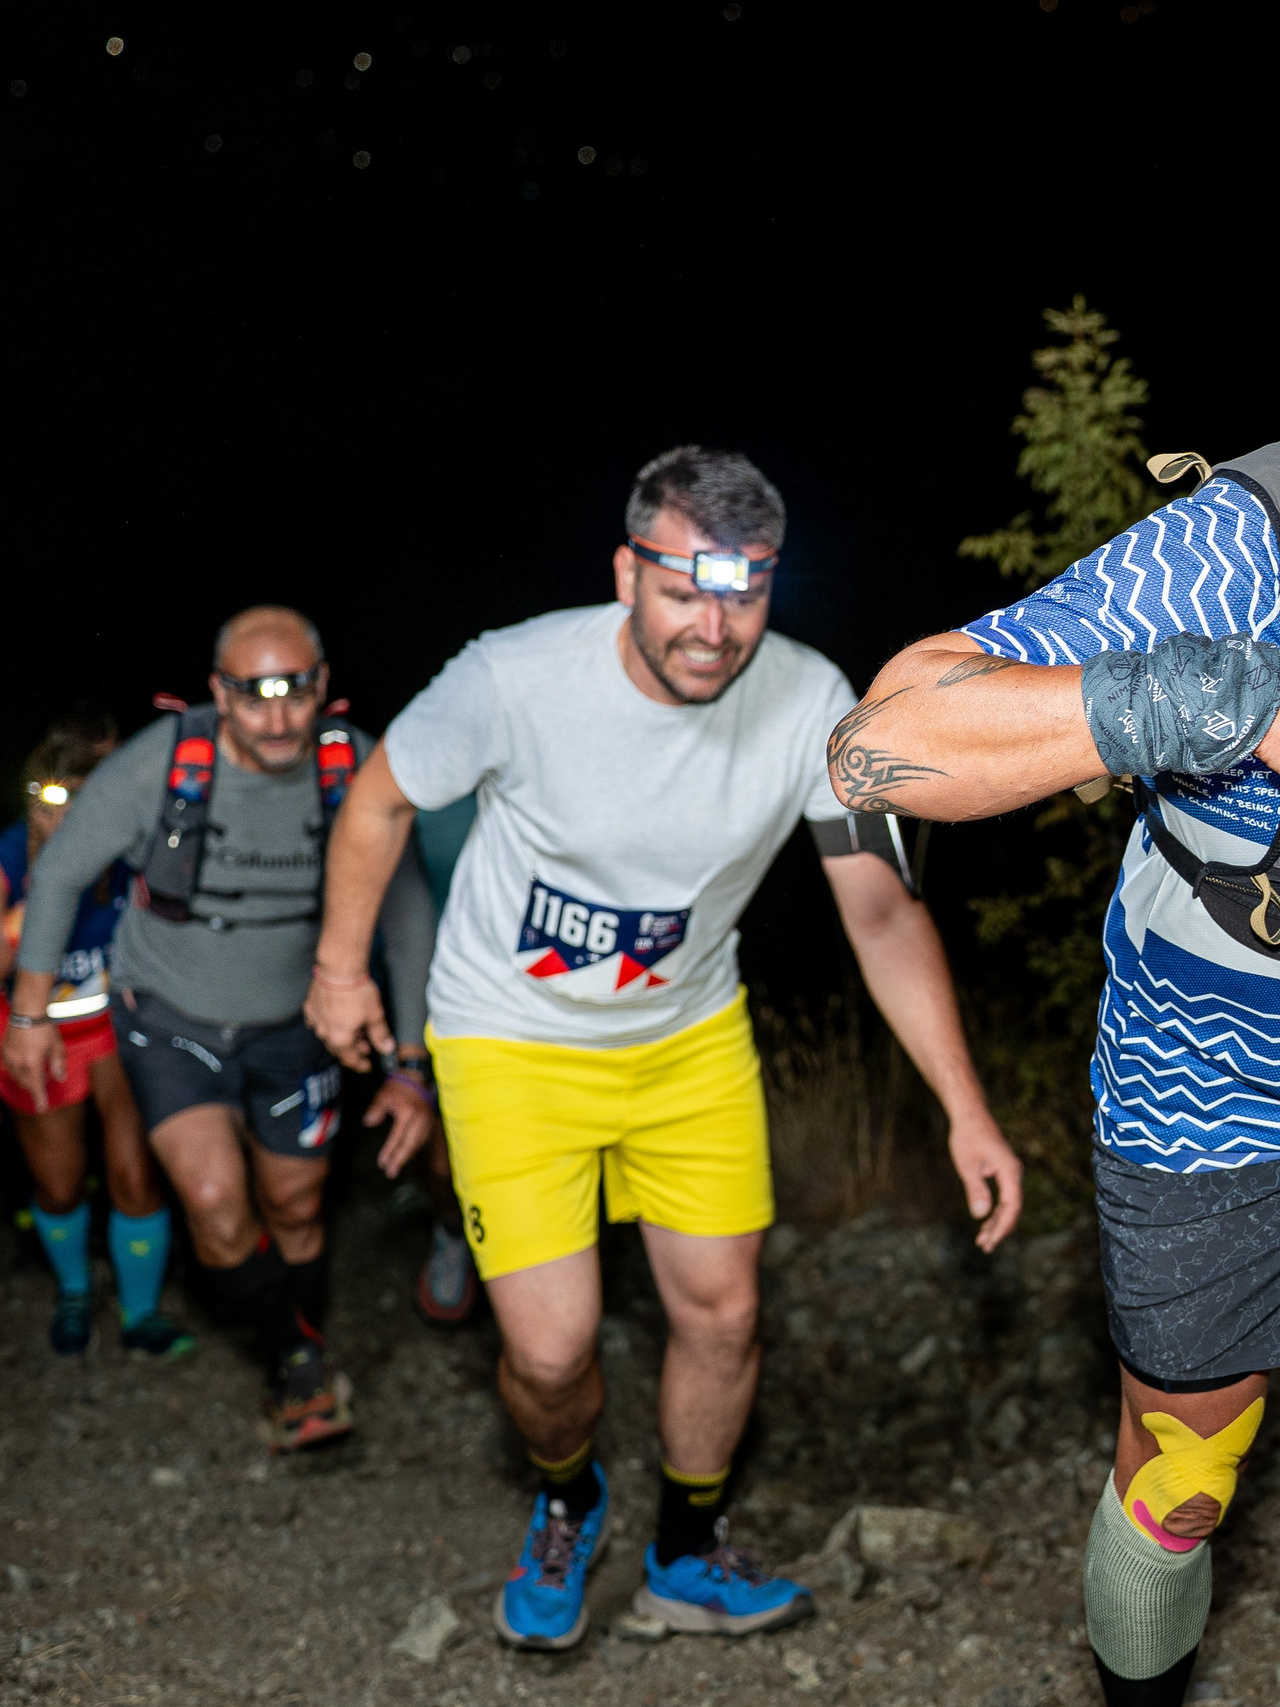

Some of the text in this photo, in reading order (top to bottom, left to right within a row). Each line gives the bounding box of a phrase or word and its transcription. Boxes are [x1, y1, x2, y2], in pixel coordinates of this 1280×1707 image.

[1219, 768, 1273, 780] EEP, YET
[1222, 781, 1250, 793] THIS
[1188, 796, 1240, 821] GLOWING
[1241, 816, 1272, 831] SOUL
[1217, 794, 1234, 805] MY
[1236, 799, 1274, 814] BEING
[530, 886, 620, 955] 1166
